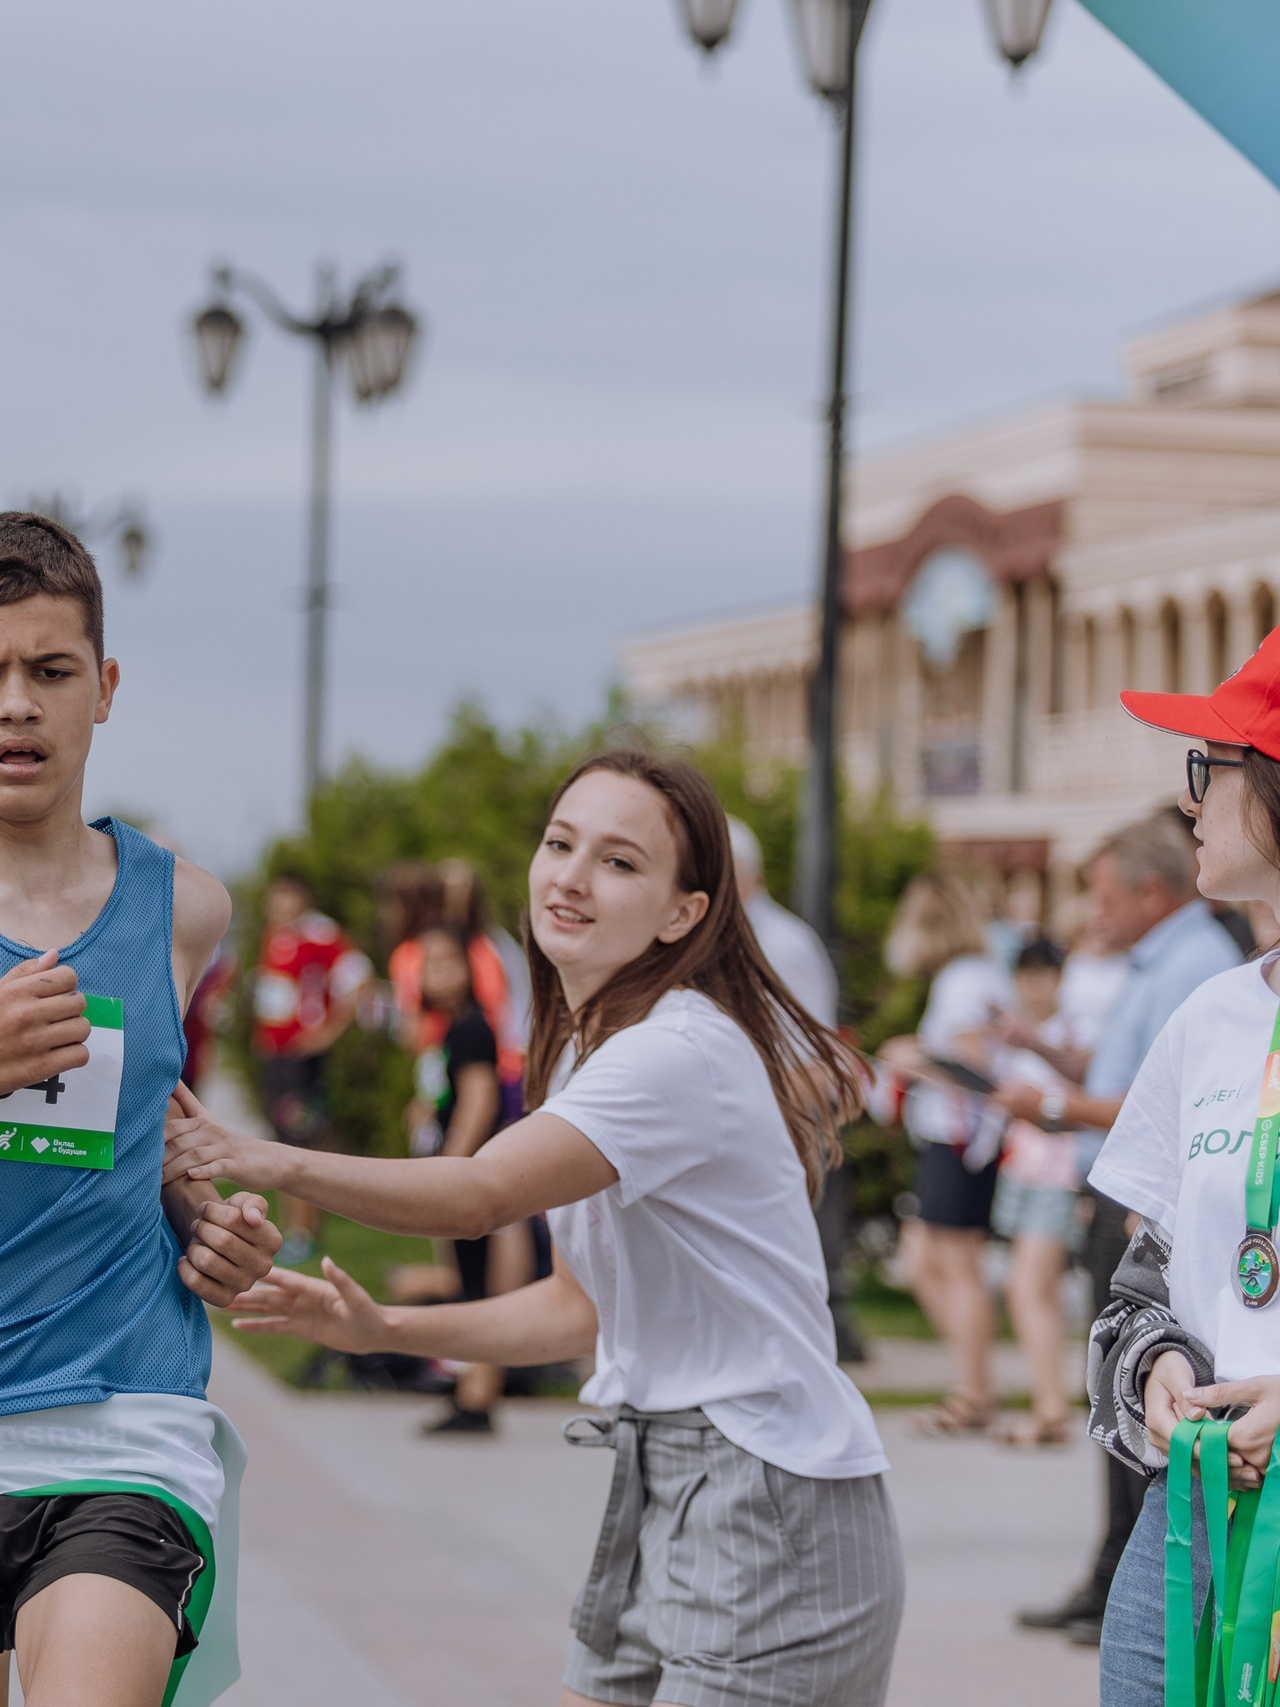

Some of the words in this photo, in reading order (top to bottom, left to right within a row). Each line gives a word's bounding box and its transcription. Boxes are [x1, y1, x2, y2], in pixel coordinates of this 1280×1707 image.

[53, 1139, 75, 1148] Вклад
[58, 1147, 87, 1156] будущее
[1259, 1133, 1269, 1159] СБЕР
[1254, 1161, 1265, 1186] KIDS
